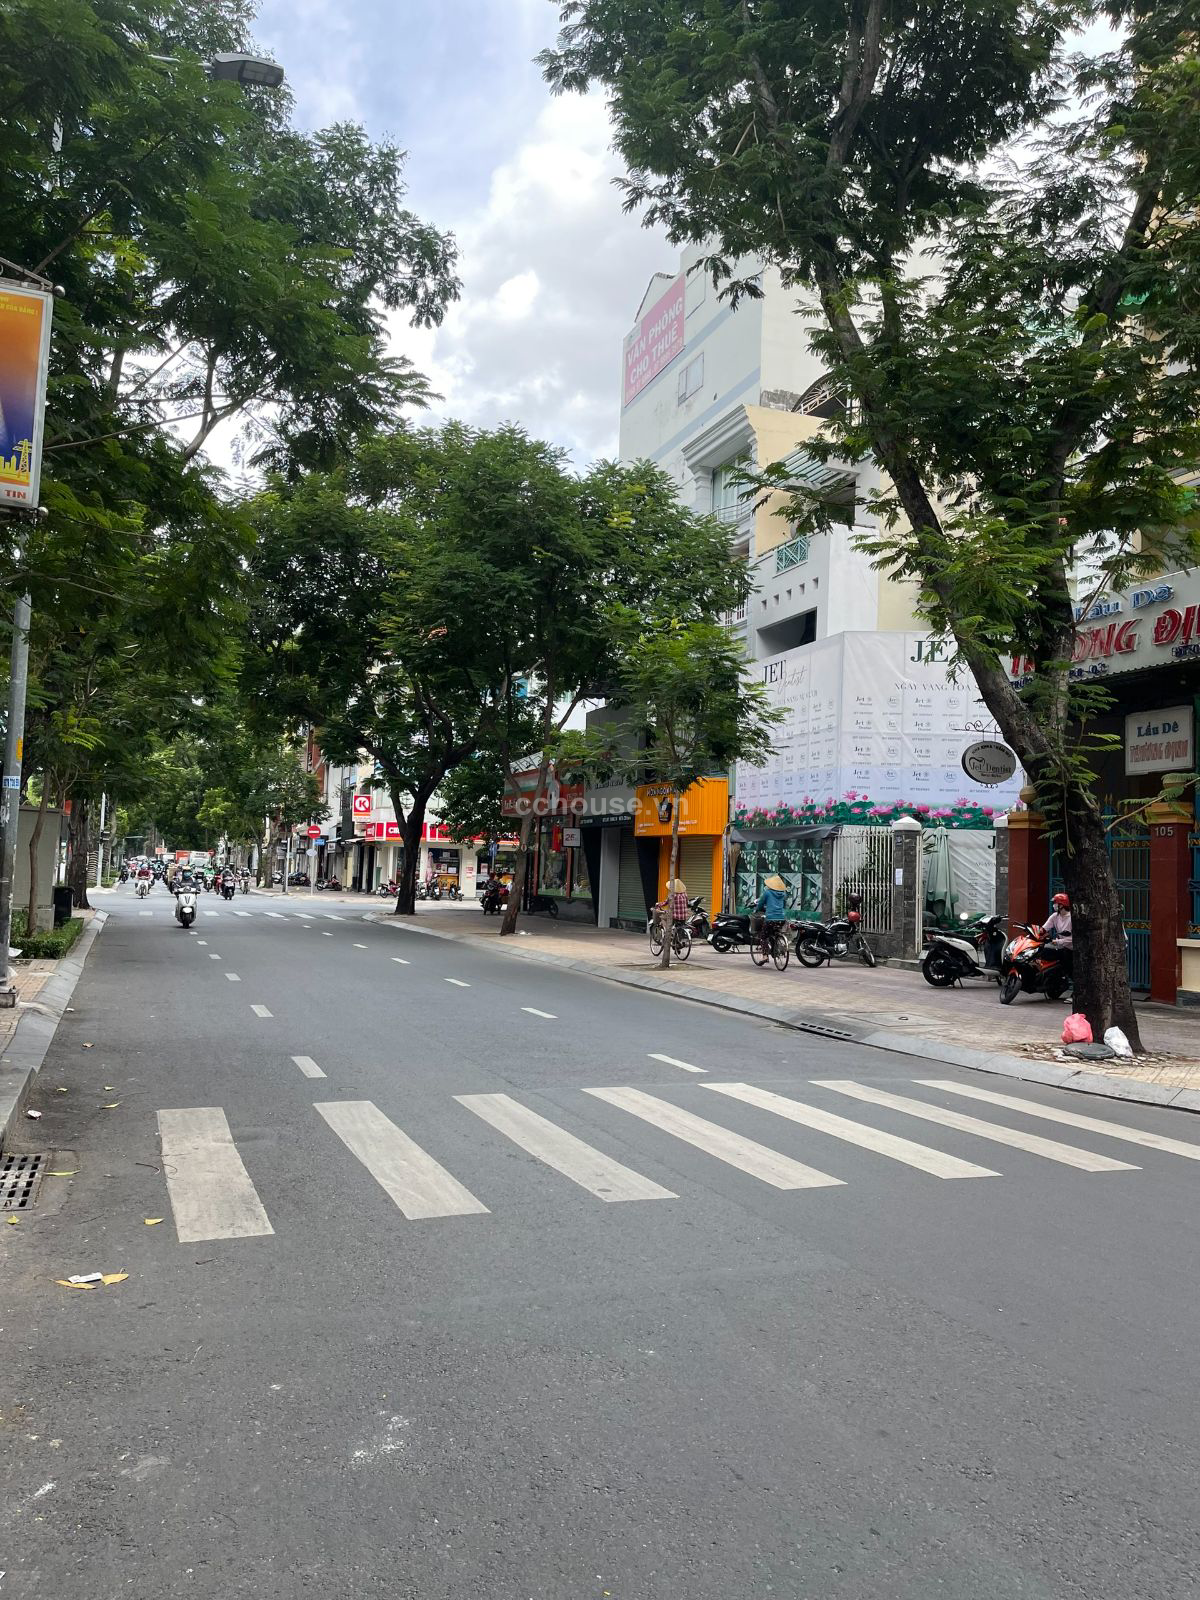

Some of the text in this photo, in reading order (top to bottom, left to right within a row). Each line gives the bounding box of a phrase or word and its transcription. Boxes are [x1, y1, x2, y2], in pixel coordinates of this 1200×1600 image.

[630, 355, 649, 384] CHO
[763, 660, 786, 684] JET
[1162, 721, 1179, 733] Dê
[1154, 826, 1174, 837] 105
